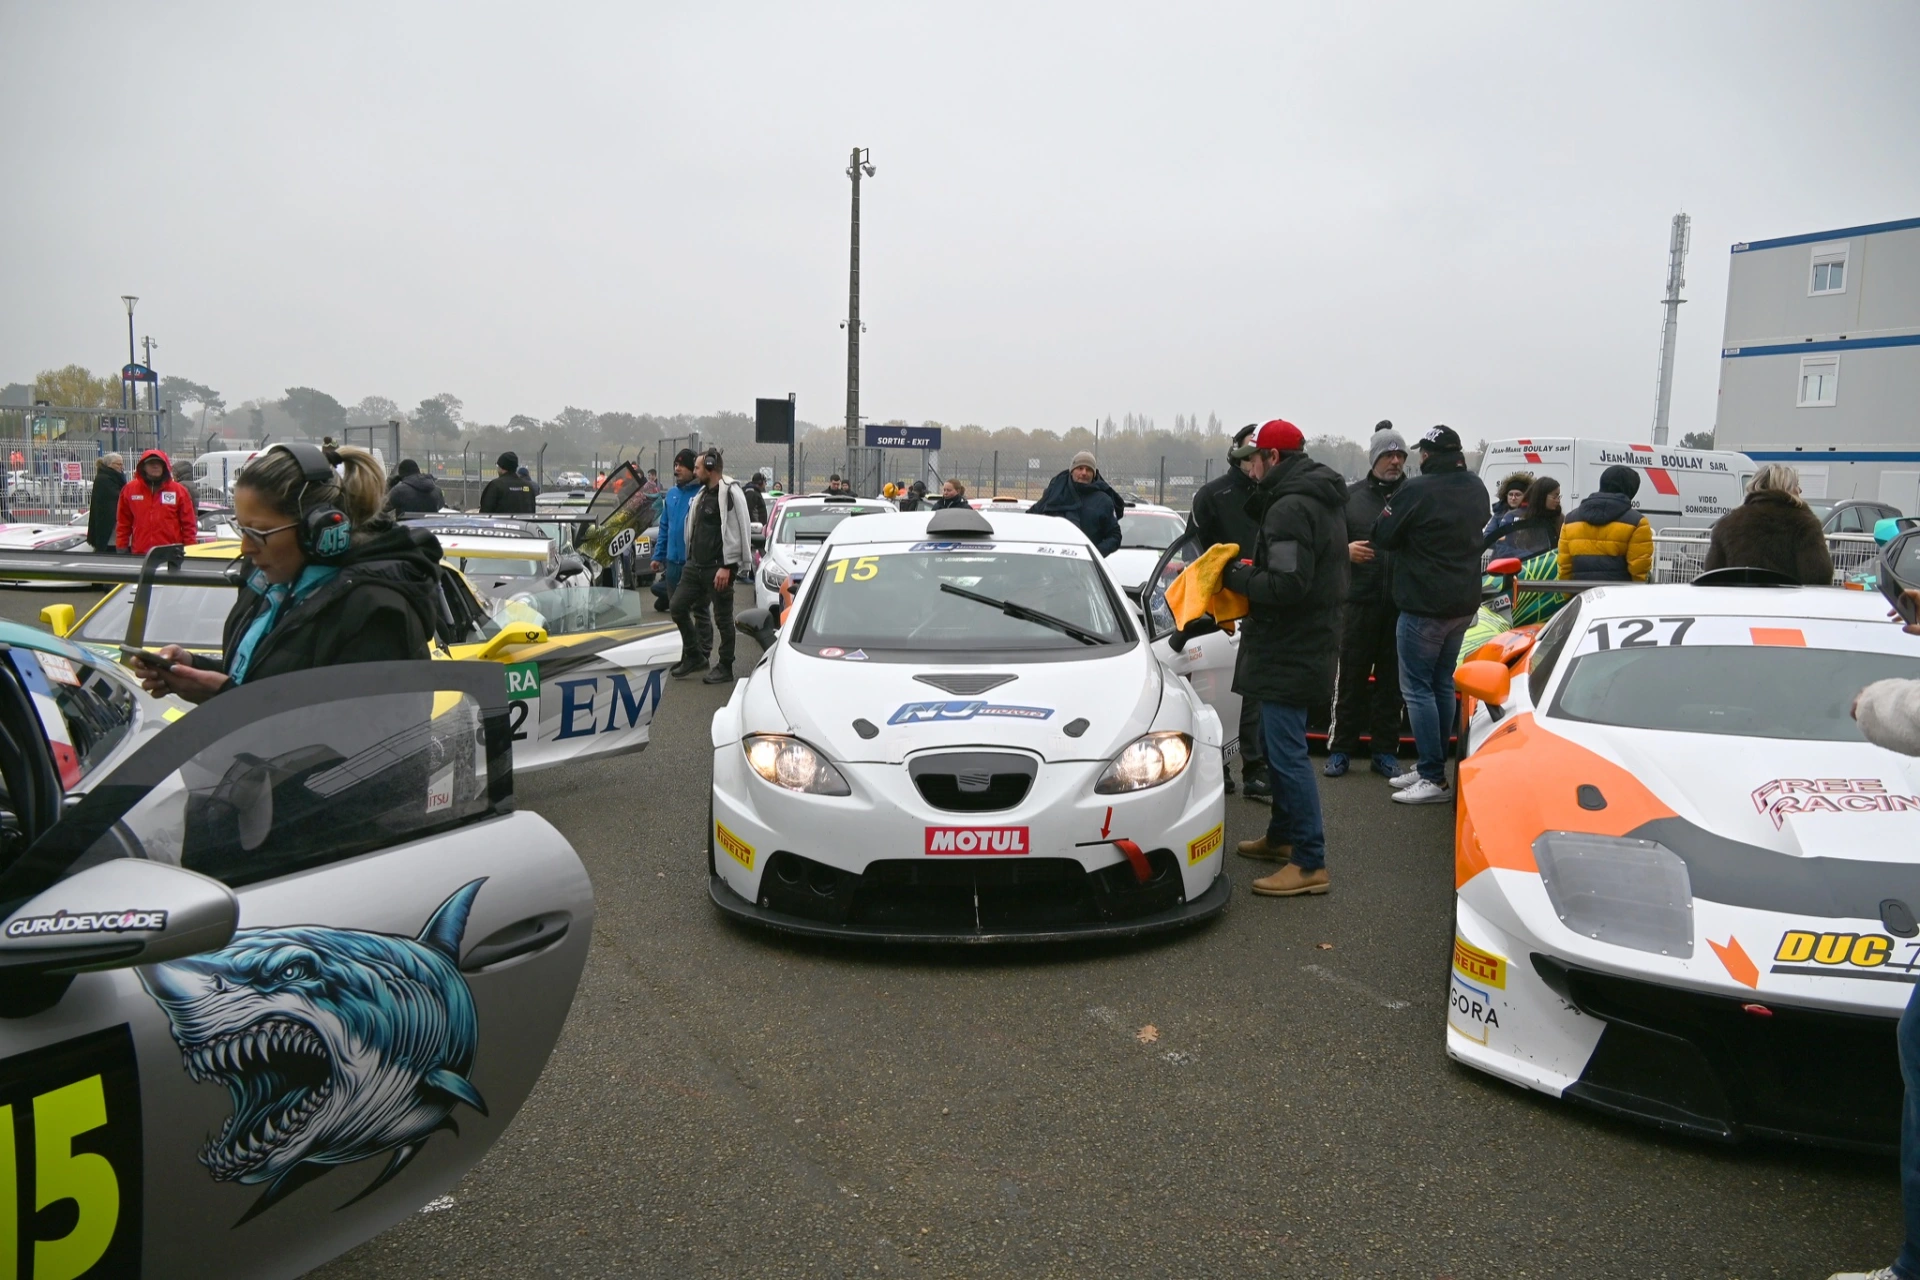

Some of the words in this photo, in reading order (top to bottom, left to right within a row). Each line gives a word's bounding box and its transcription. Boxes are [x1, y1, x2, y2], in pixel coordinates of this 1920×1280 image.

[877, 437, 905, 445] SORTIE
[912, 438, 930, 446] EXIT
[1661, 455, 1703, 469] BOULAY
[1709, 461, 1728, 471] SARL
[1698, 495, 1718, 504] VIDEO
[318, 522, 351, 554] 415
[611, 529, 631, 555] 666
[636, 542, 650, 554] 79
[826, 556, 880, 584] 15
[1588, 617, 1696, 650] 127
[505, 669, 538, 693] RA
[552, 668, 667, 742] EM
[895, 702, 982, 725] NJ
[1751, 778, 1888, 814] FREE
[717, 823, 751, 865] PIRELLI
[930, 830, 1025, 851] MOTUL
[1190, 826, 1222, 860] PIRELLI
[1774, 930, 1894, 967] DUC
